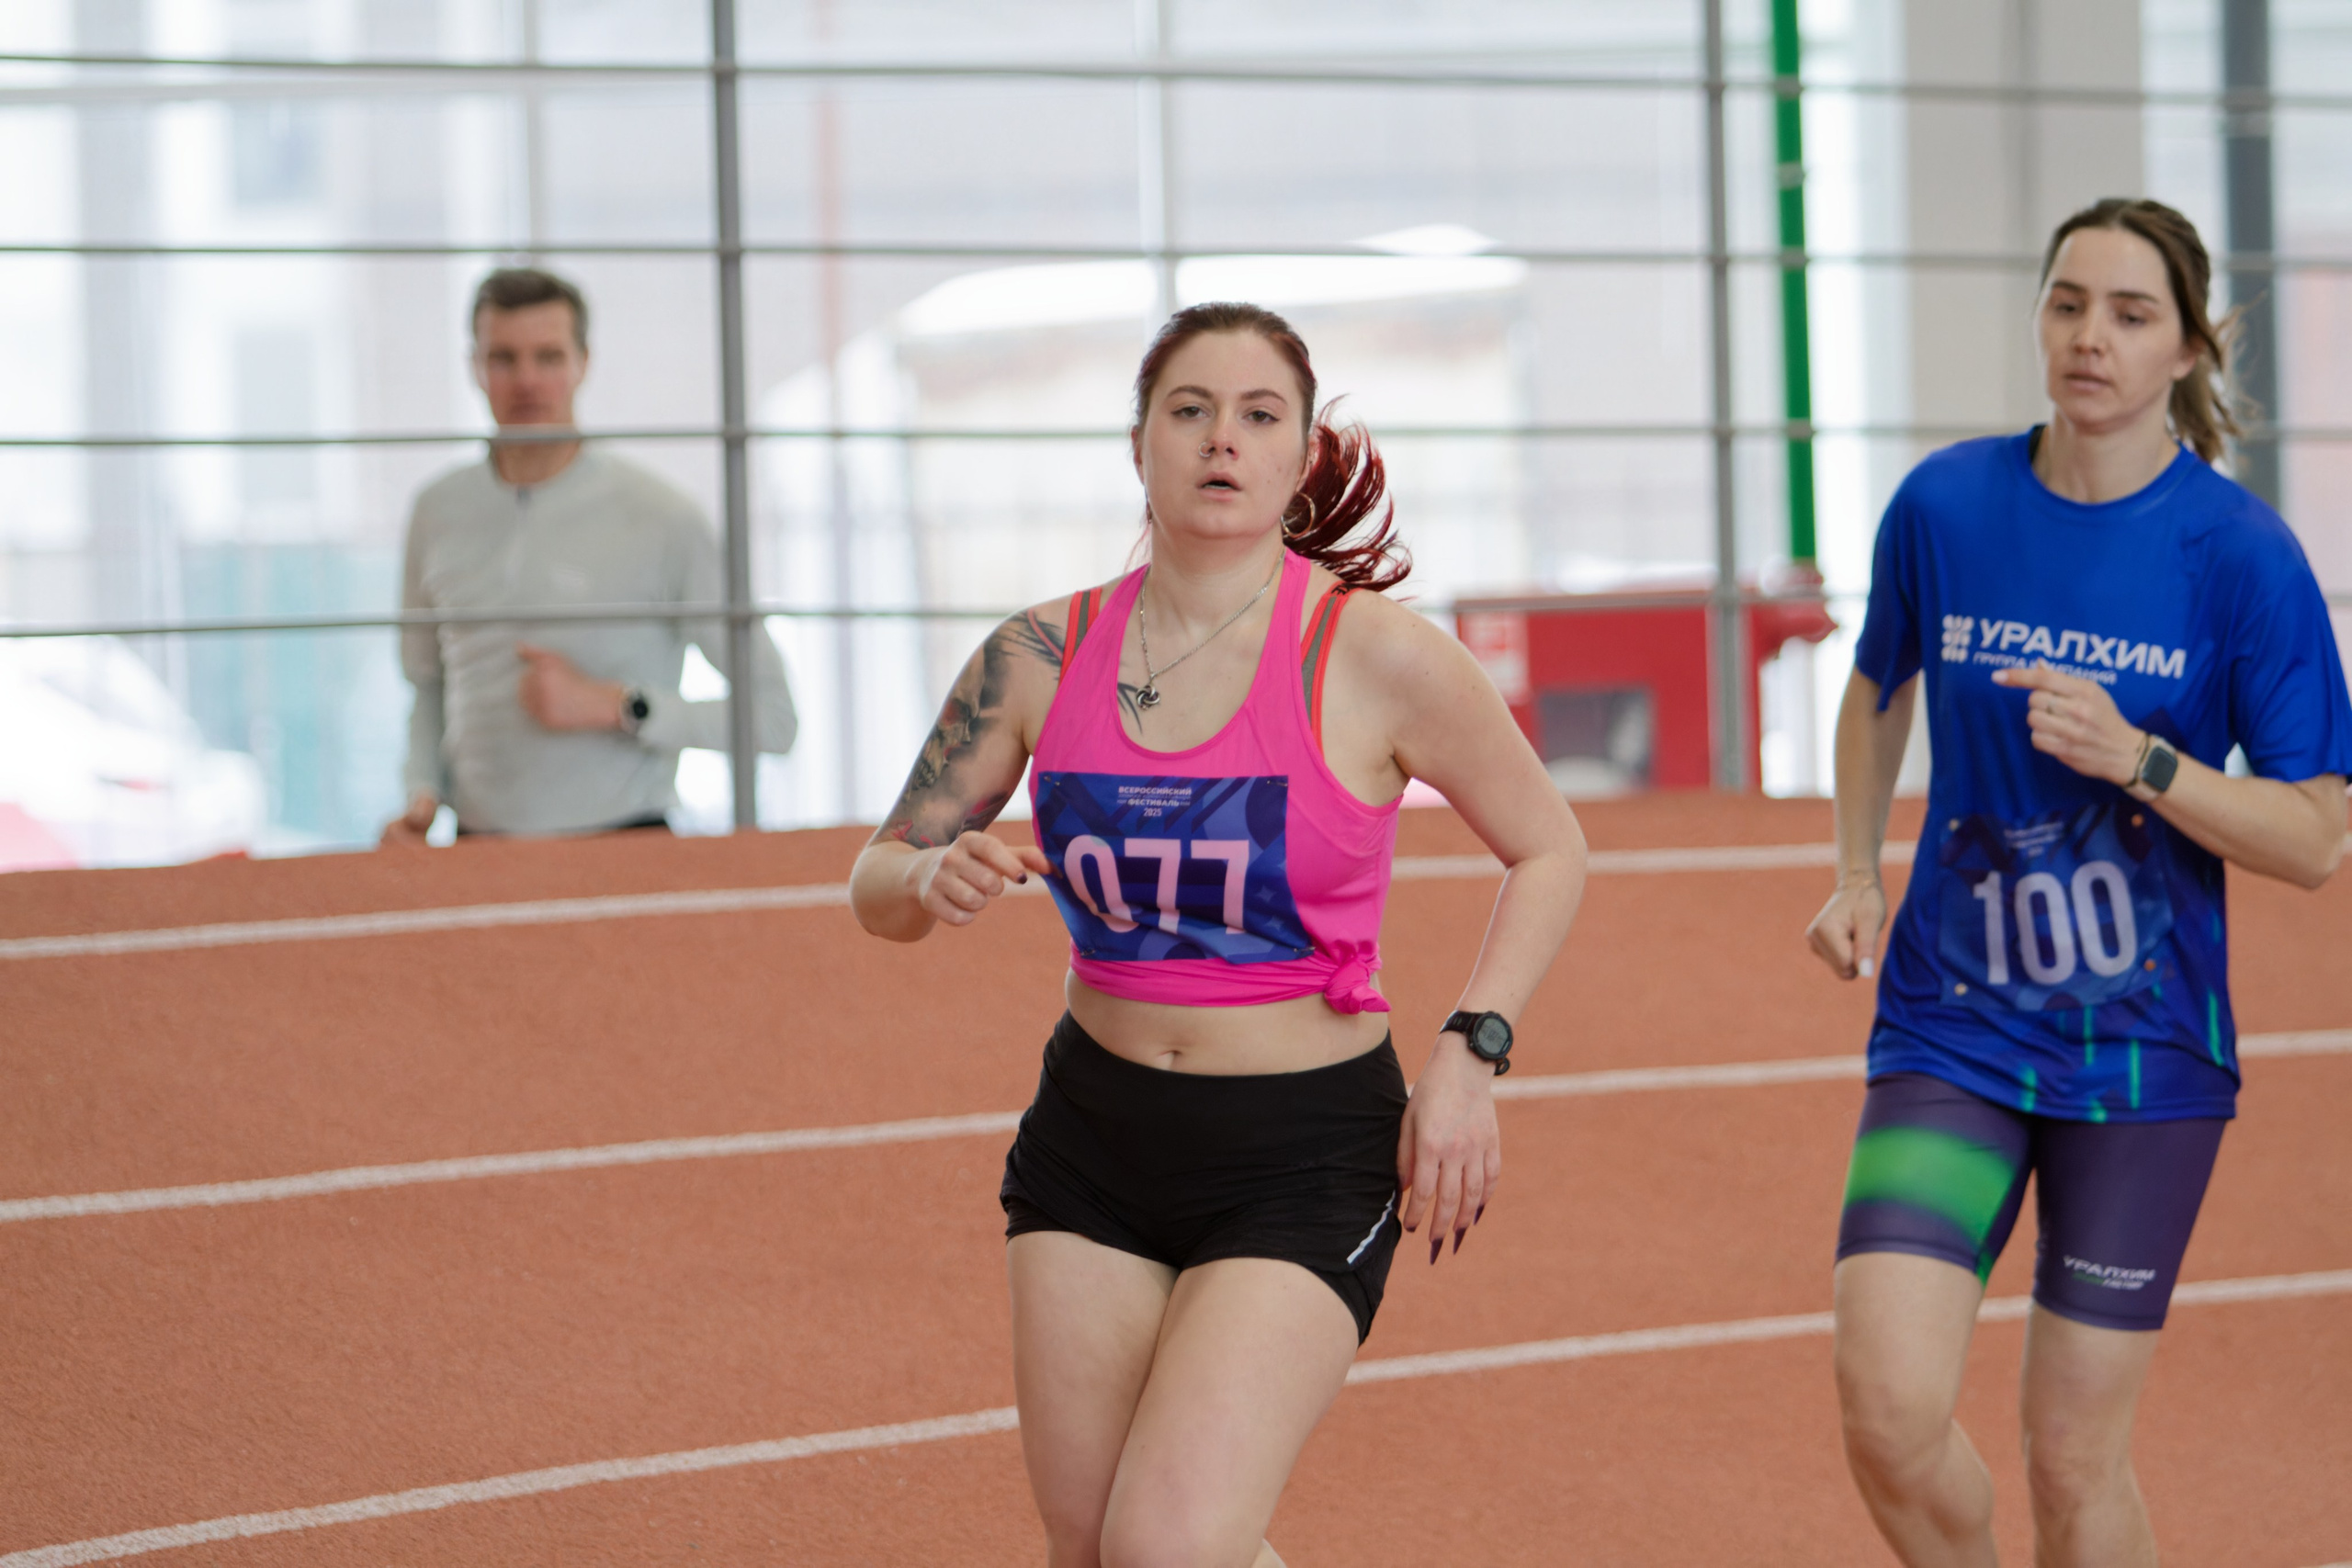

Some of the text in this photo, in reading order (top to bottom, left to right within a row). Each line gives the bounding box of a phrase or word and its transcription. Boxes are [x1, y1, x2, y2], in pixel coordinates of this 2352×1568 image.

[1980, 618, 2187, 679] УРАЛХИМ
[1118, 786, 1192, 795] ВСЕРОССИЙСКИЙ
[1127, 798, 1179, 807] ФЕСТИВАЛЬ
[1144, 807, 1162, 817] 2025
[1065, 835, 1250, 933] 077
[1973, 861, 2137, 986] 100
